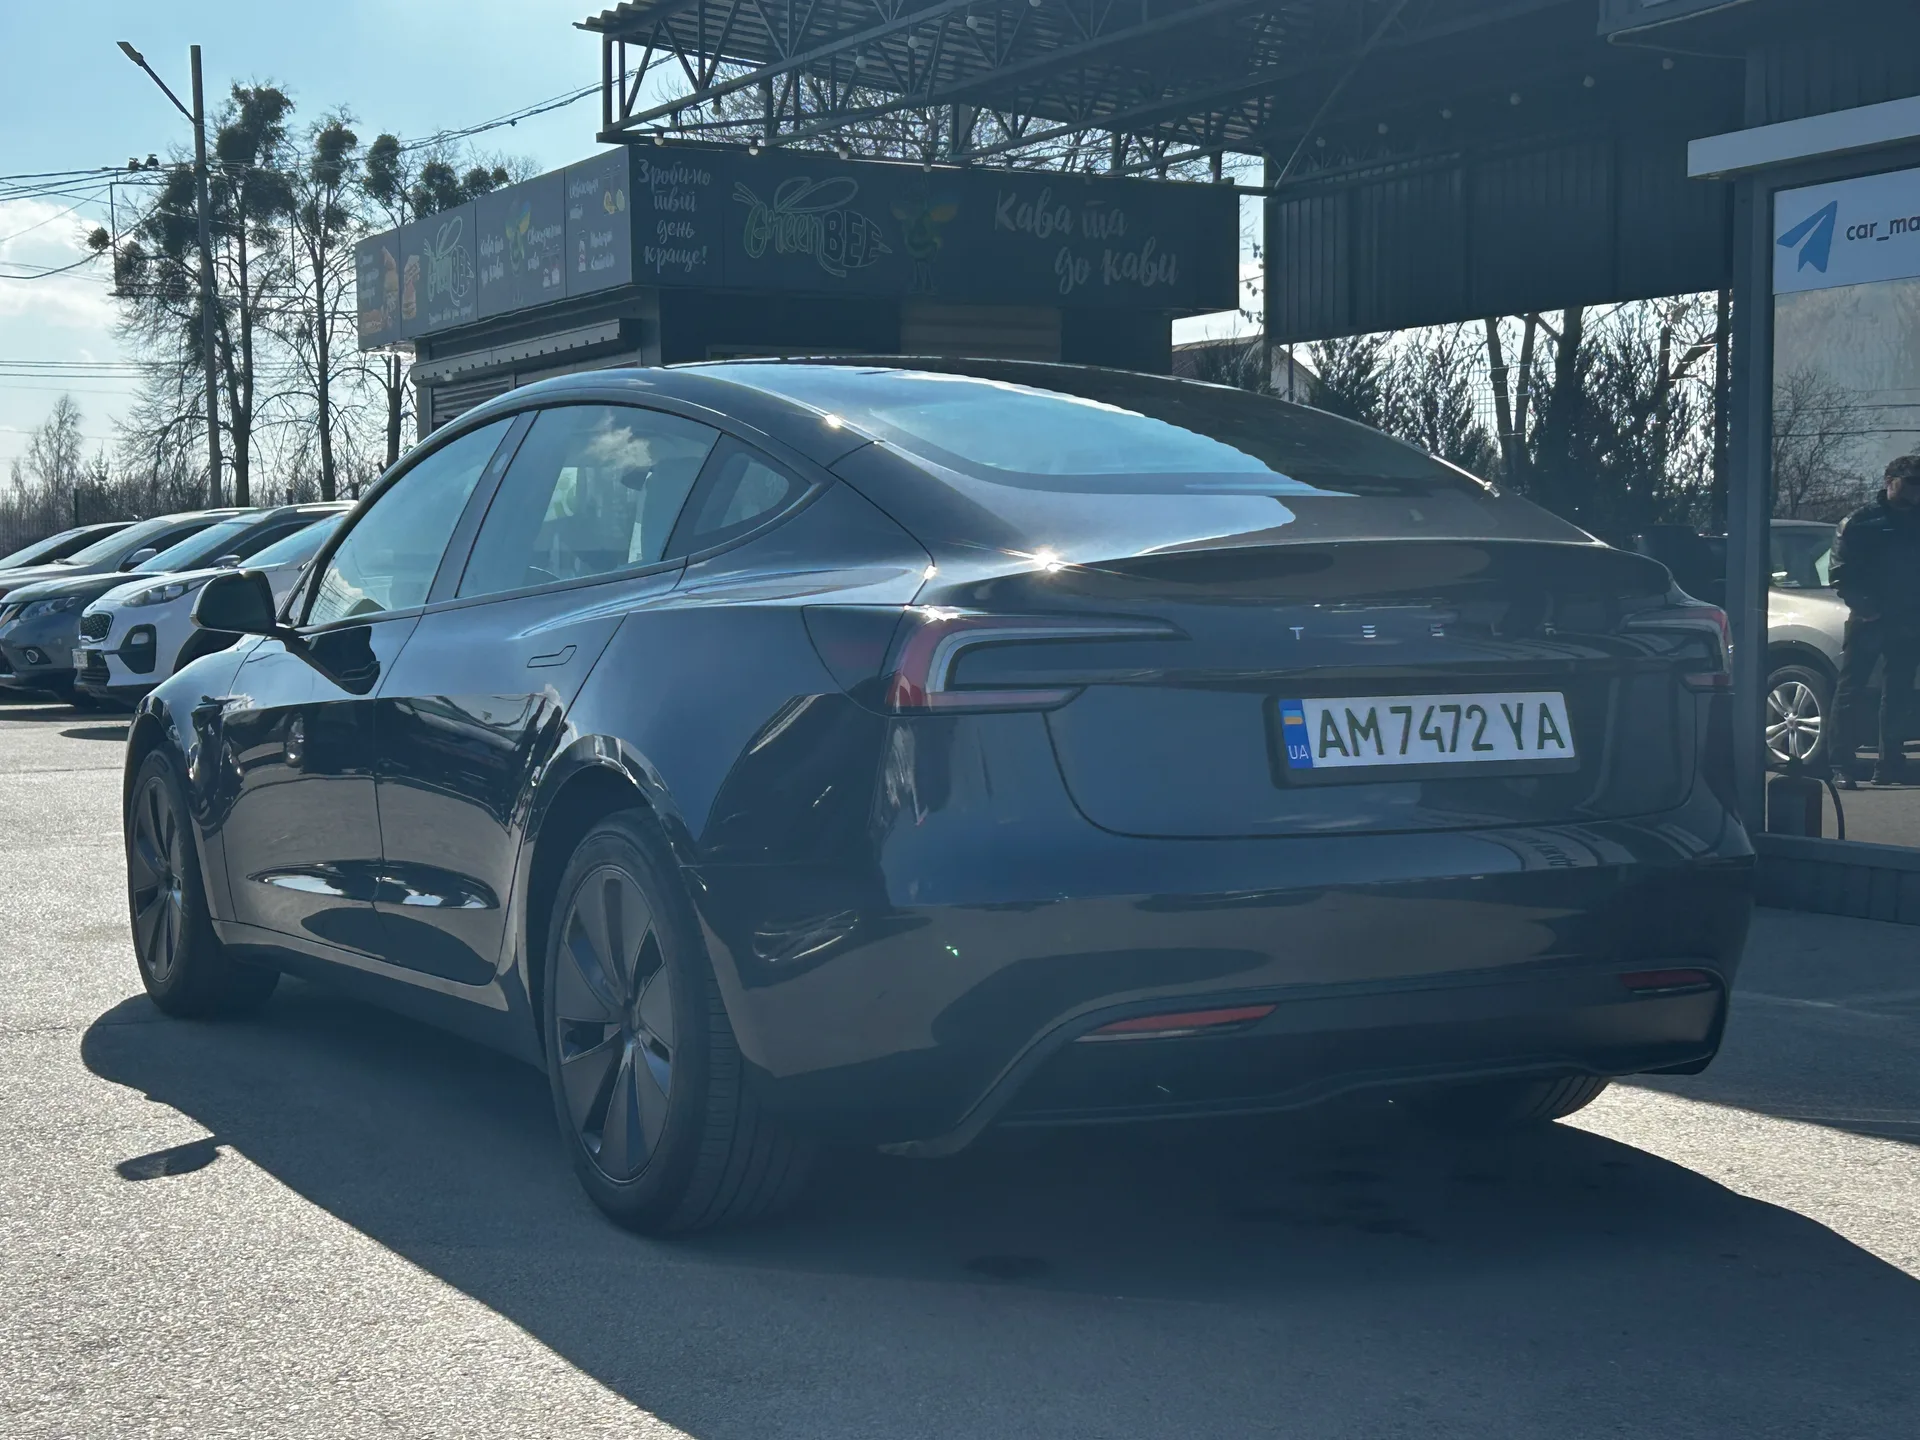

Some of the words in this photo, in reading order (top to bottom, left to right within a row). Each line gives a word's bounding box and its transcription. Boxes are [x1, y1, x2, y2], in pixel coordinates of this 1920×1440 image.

[995, 187, 1074, 239] Кава
[1081, 200, 1128, 239] та
[657, 220, 695, 244] день
[643, 246, 707, 274] краще!
[1055, 247, 1091, 294] до
[1101, 236, 1179, 287] кави
[1288, 745, 1309, 760] UA
